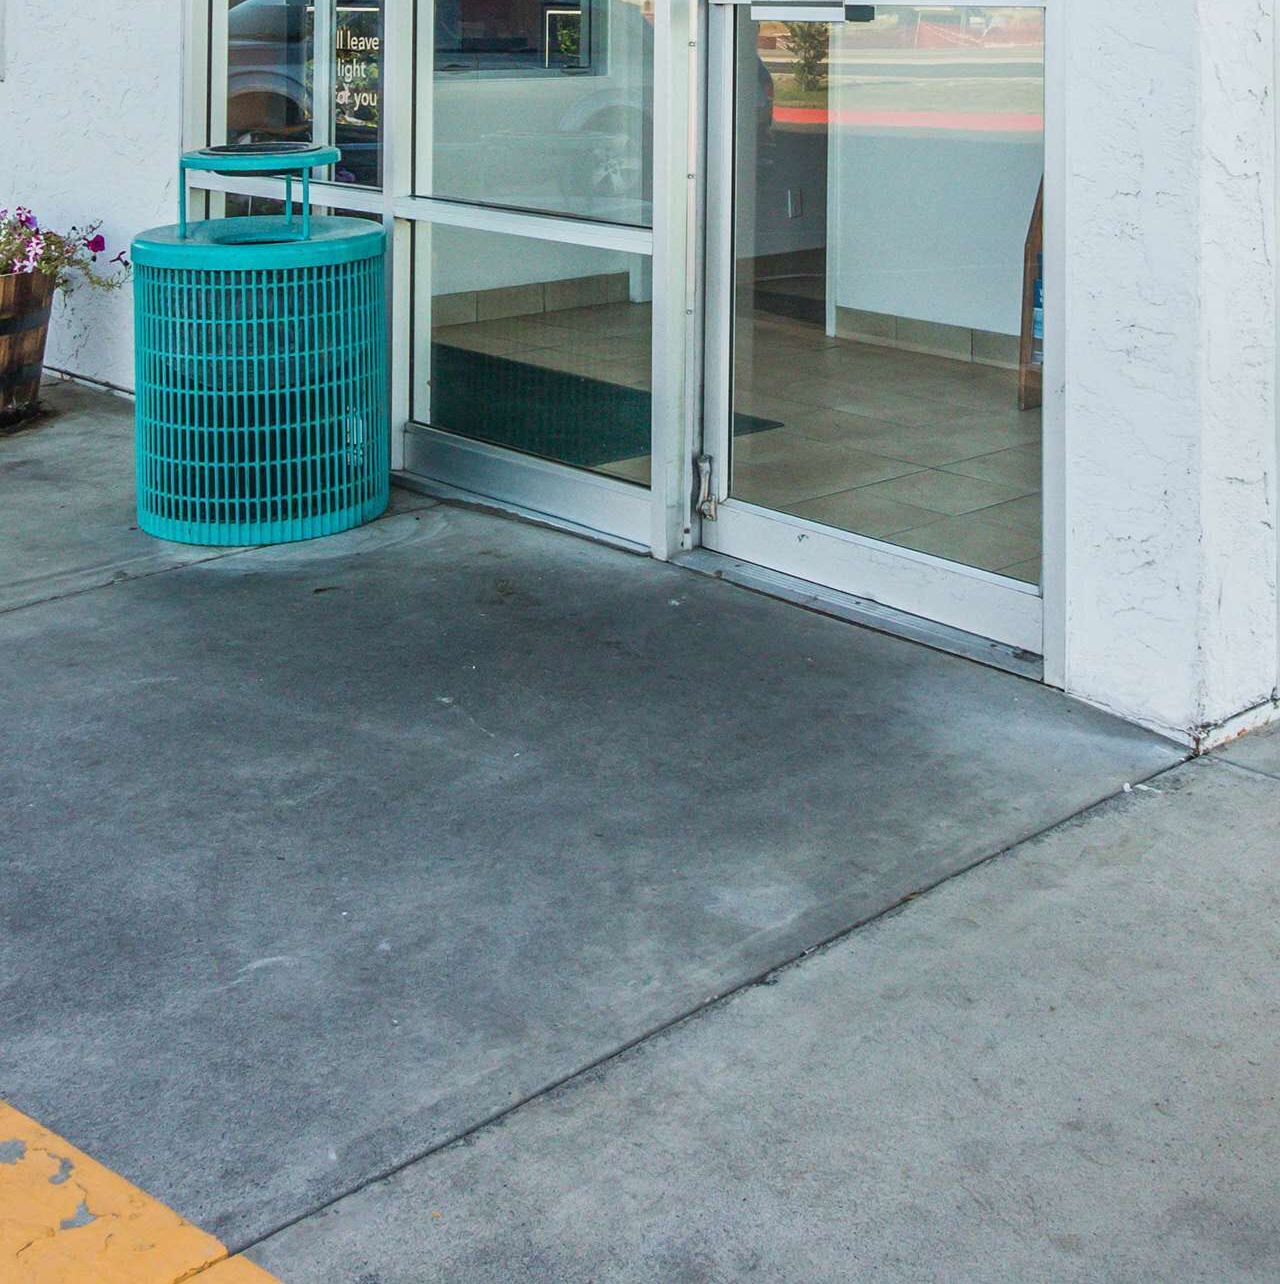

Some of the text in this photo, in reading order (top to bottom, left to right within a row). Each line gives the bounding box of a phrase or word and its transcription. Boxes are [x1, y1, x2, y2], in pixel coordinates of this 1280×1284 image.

[348, 30, 379, 50] leave
[337, 58, 367, 82] light
[336, 86, 377, 110] or you
